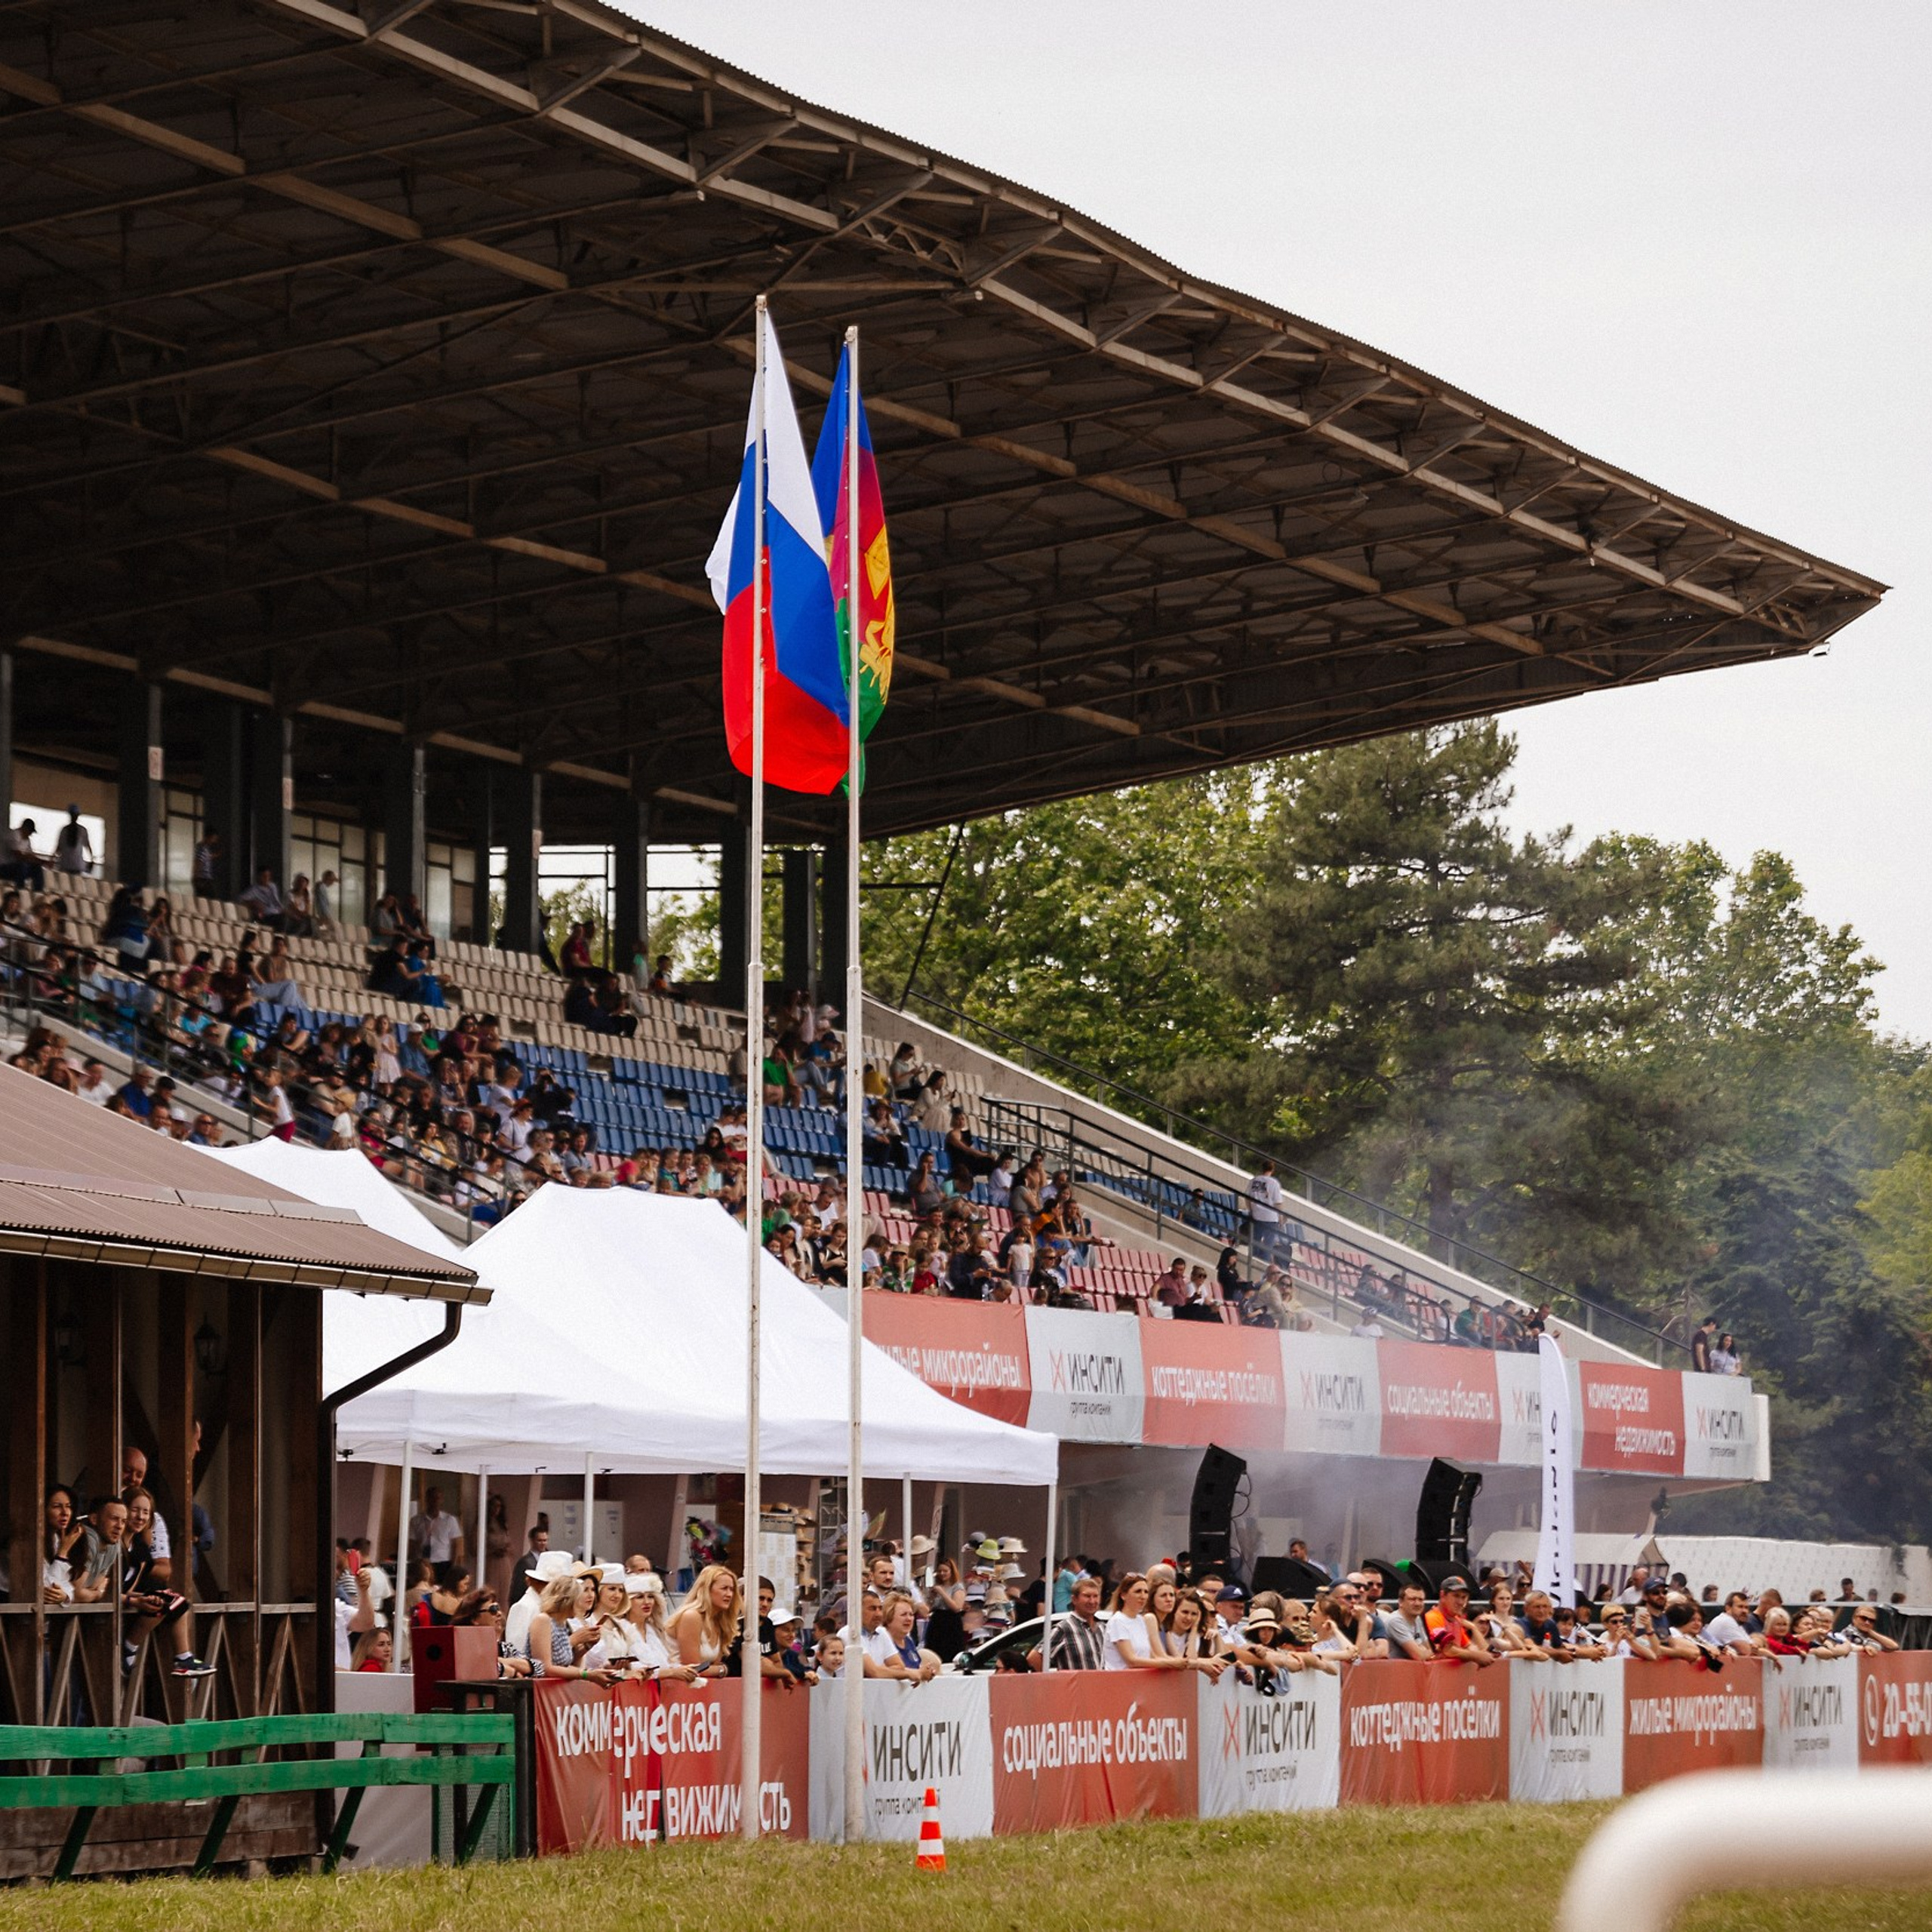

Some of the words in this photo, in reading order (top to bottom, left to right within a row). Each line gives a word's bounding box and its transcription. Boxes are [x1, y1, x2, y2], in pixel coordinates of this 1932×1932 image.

[921, 1342, 1022, 1398] микрорайоны
[1067, 1352, 1124, 1395] ИНСИТИ
[1152, 1366, 1227, 1407] коттеджные
[1315, 1374, 1364, 1412] ИНСИТИ
[1707, 1409, 1744, 1441] ИНСИТИ
[1246, 1701, 1316, 1756] ИНСИТИ
[1350, 1702, 1441, 1752] коттеджные
[1443, 1685, 1500, 1740] посёлки
[1549, 1690, 1604, 1737] ИНСИТИ
[1629, 1697, 1672, 1734] жилые
[1673, 1681, 1757, 1746] микрорайоны
[1794, 1685, 1842, 1727] ИНСИТИ
[873, 1721, 961, 1783] ИНСИТИ
[1004, 1717, 1112, 1780] социальные
[1115, 1701, 1187, 1764] объекты
